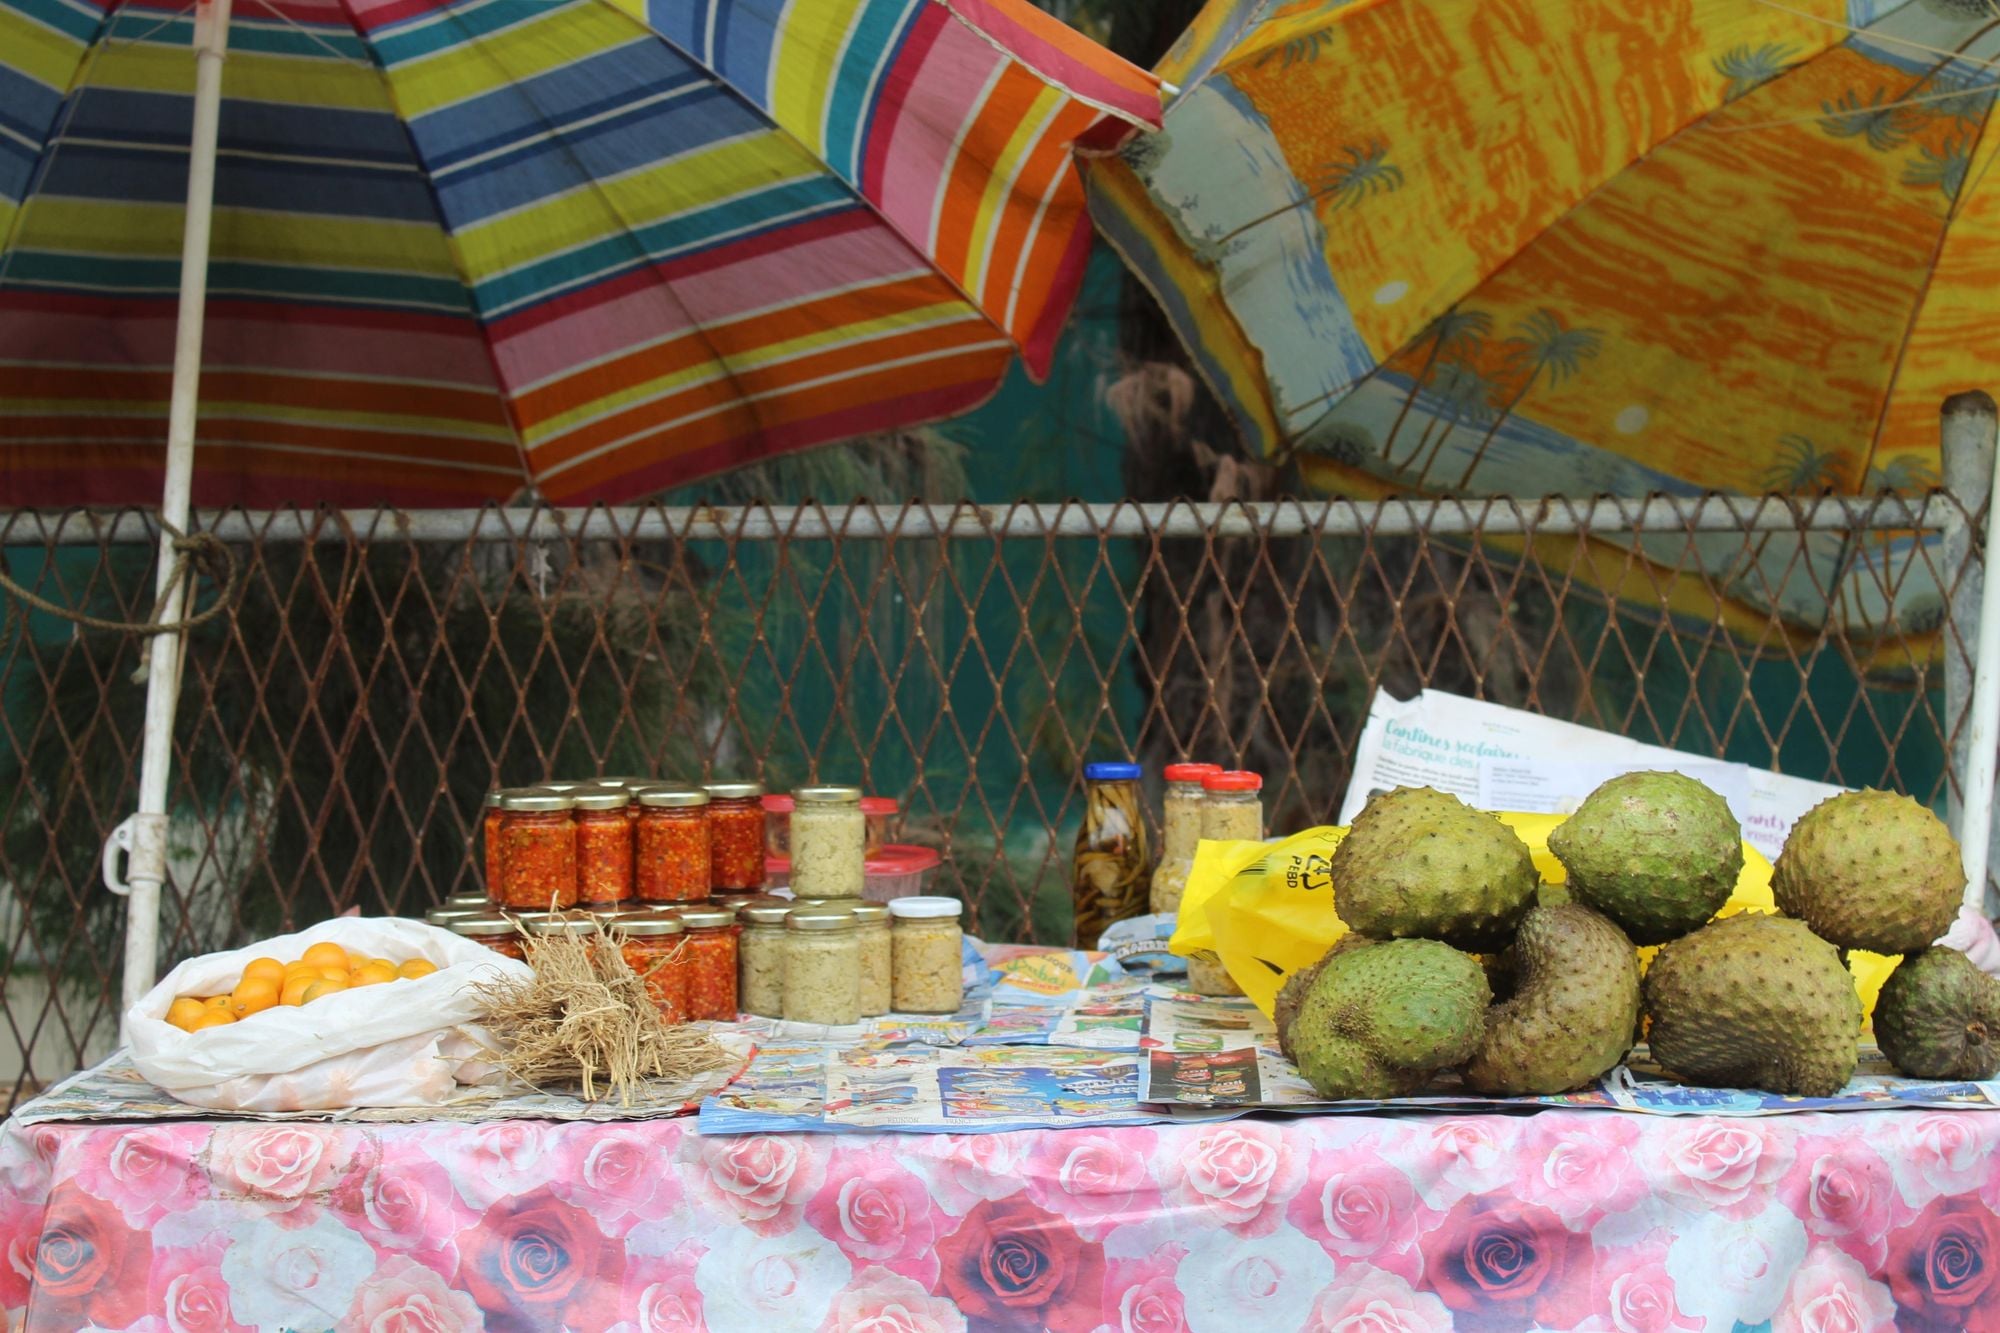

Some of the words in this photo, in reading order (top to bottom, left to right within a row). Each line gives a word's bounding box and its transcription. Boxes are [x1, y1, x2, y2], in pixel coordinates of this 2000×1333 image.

[1385, 718, 1450, 750] Cantines
[1391, 739, 1447, 764] fabrique
[1286, 855, 1302, 889] PEBD
